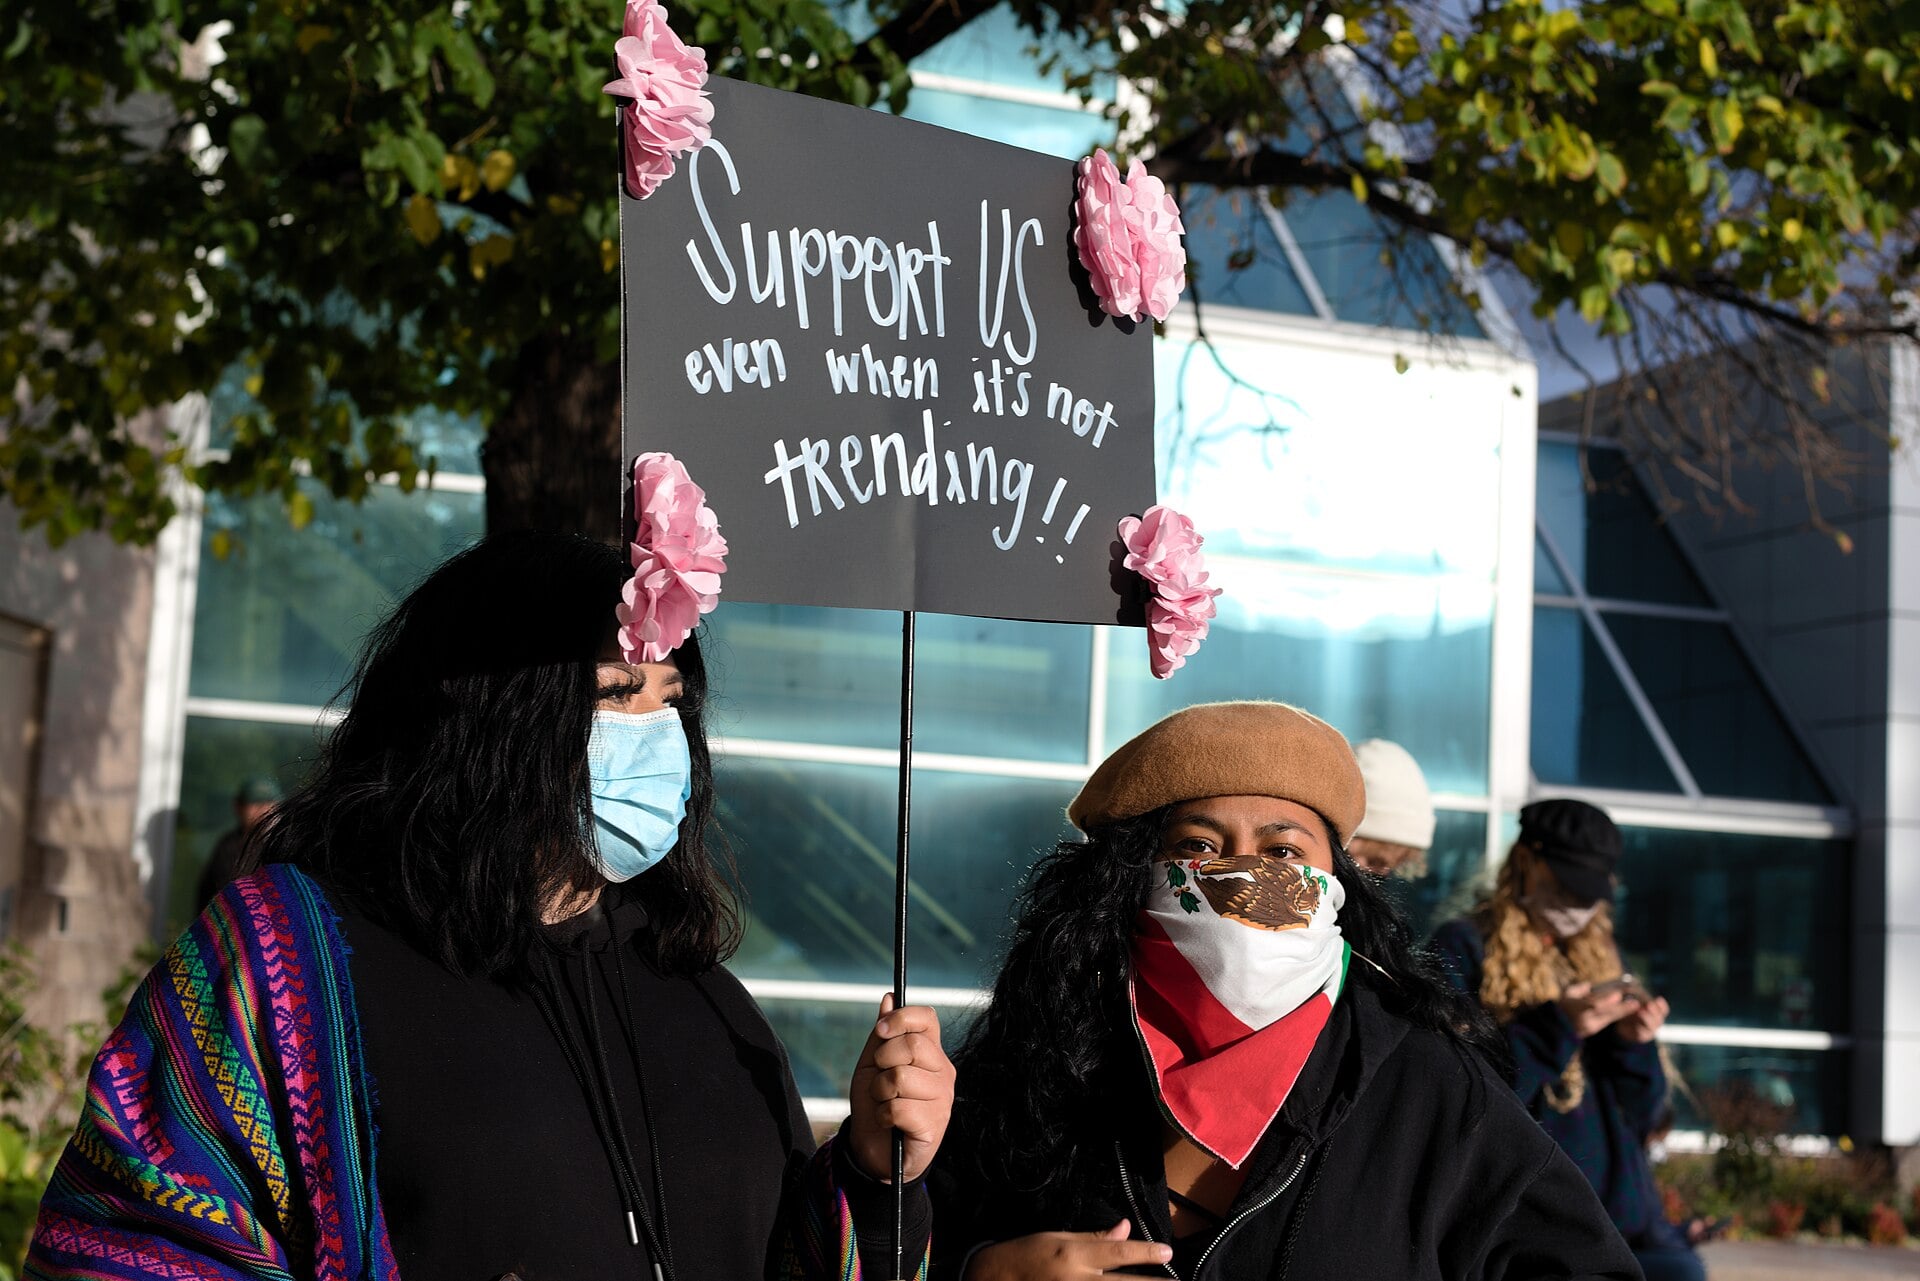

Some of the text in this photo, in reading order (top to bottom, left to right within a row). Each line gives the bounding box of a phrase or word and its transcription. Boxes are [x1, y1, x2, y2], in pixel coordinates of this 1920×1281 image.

[979, 199, 1044, 365] US
[685, 337, 1119, 449] even when it's not
